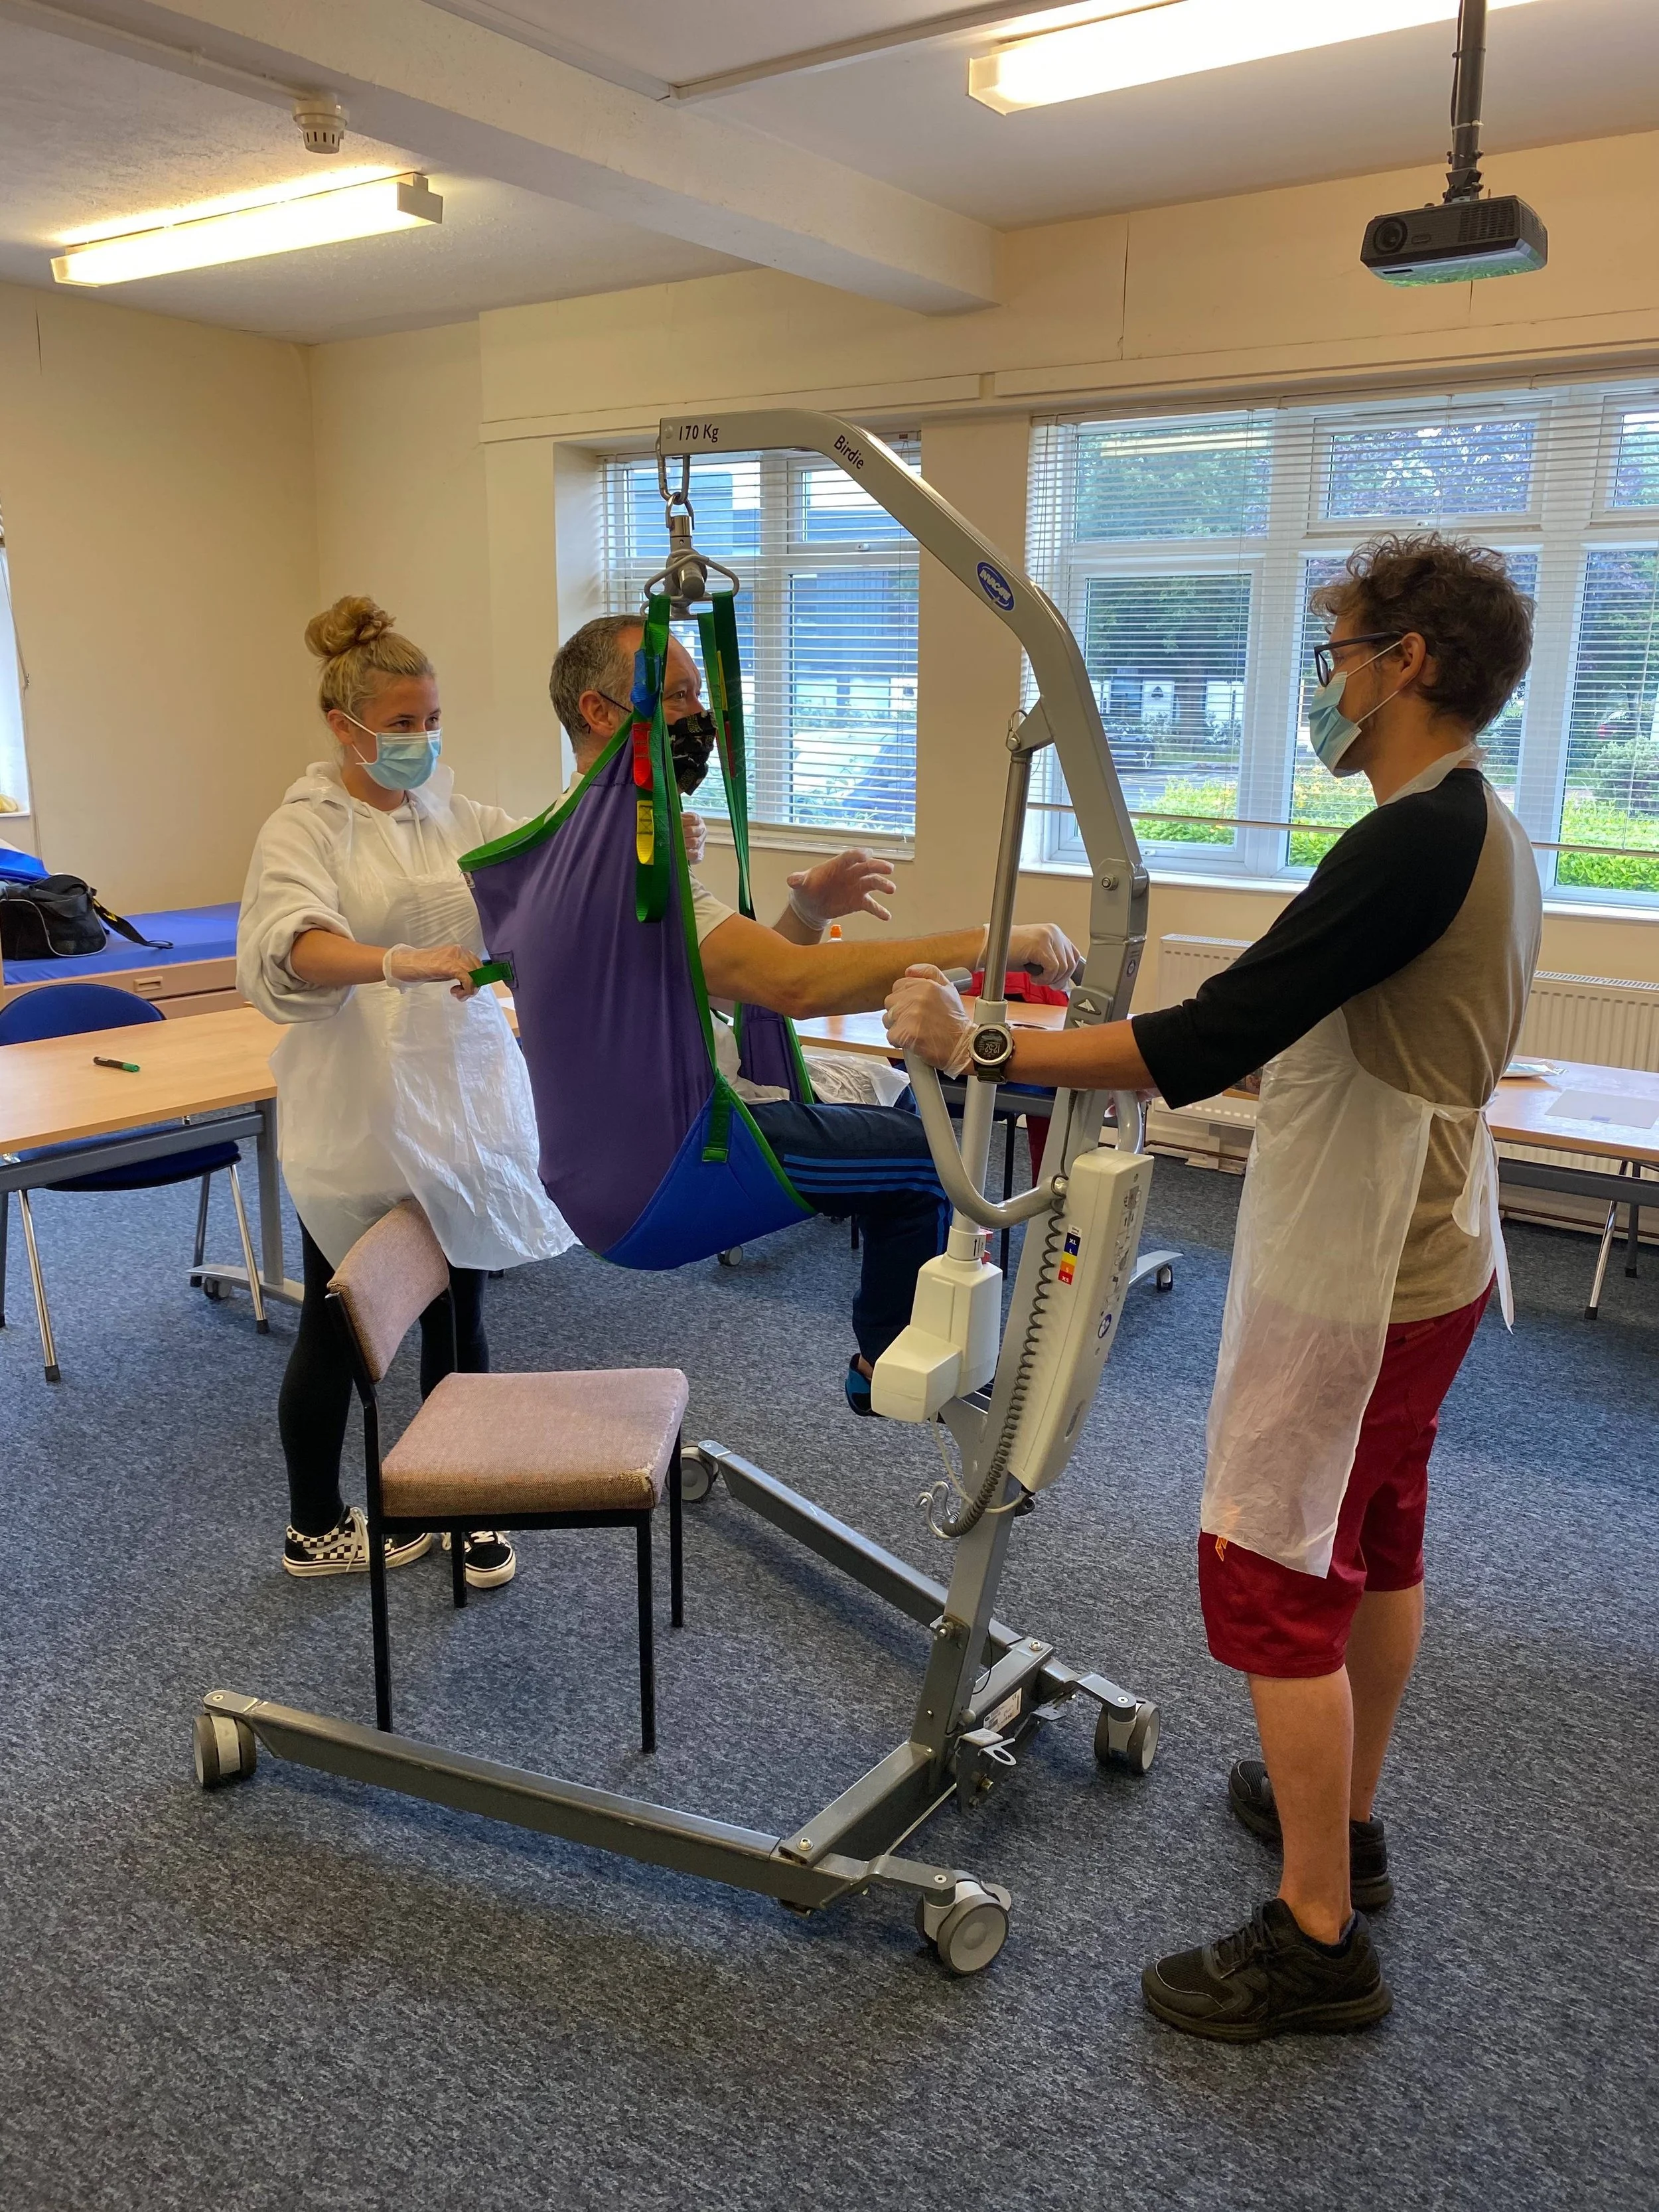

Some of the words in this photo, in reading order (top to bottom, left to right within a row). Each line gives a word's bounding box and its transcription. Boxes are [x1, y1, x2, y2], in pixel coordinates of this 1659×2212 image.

[679, 425, 699, 441] 170
[703, 423, 719, 443] Kg
[833, 434, 864, 469] Birdie
